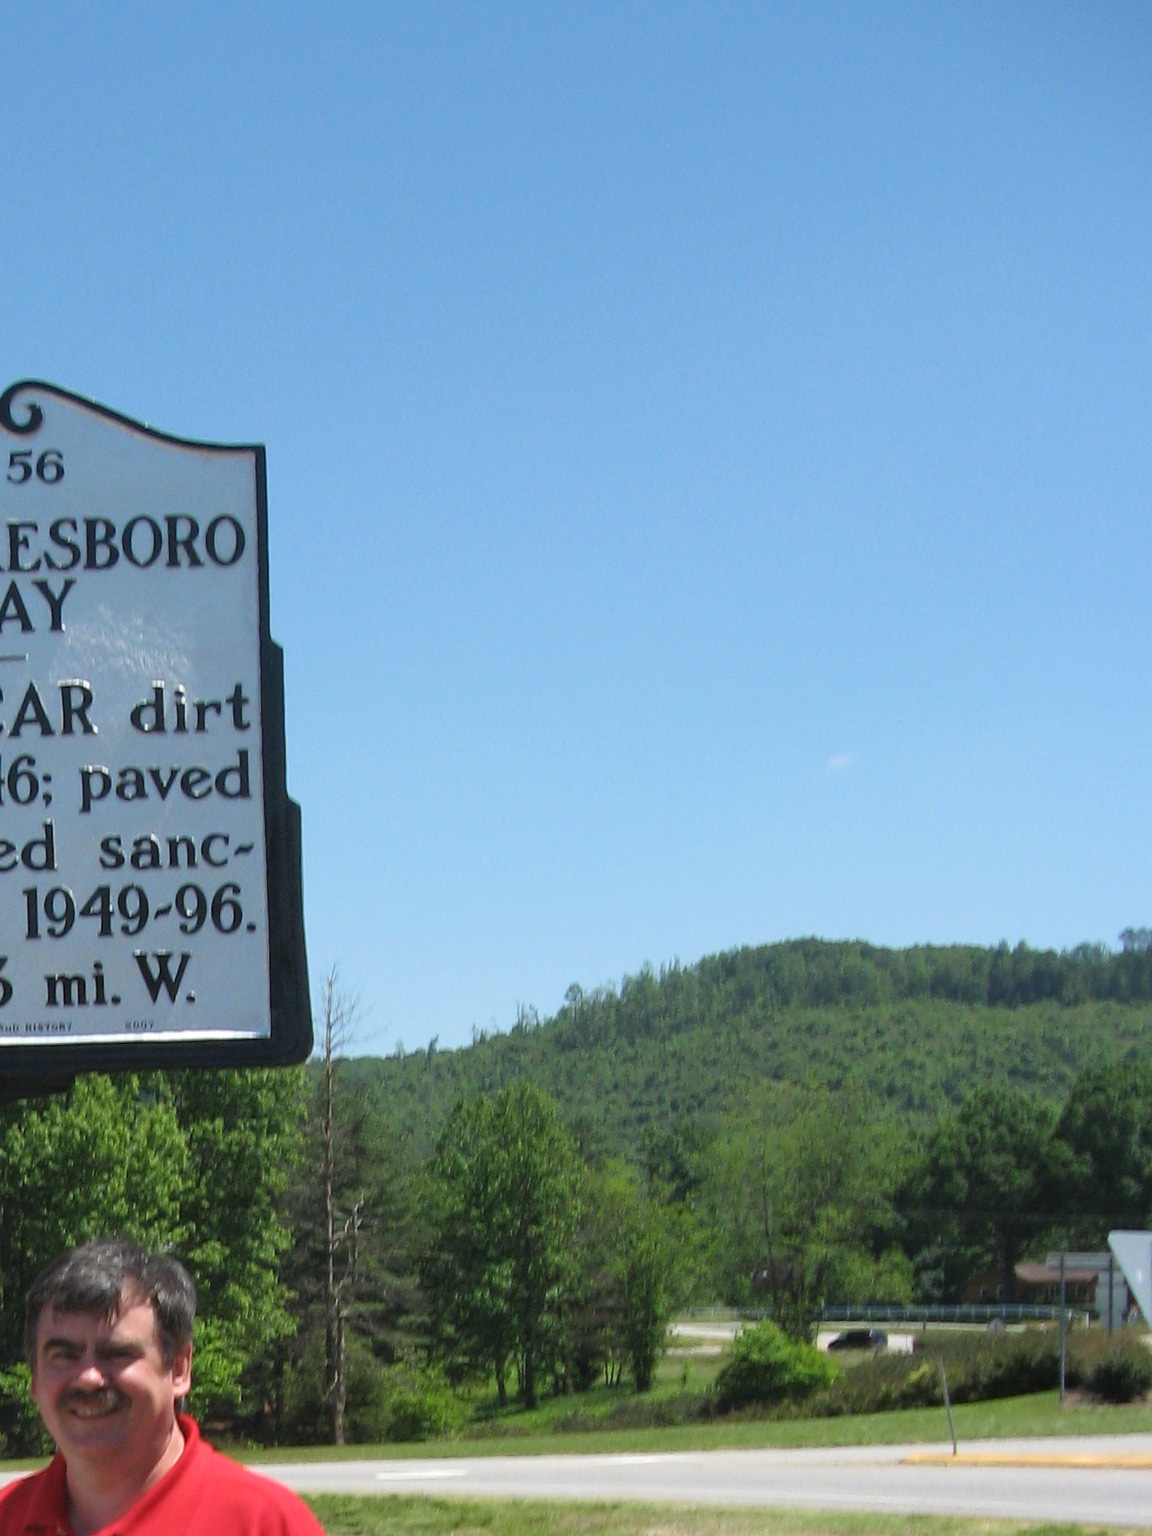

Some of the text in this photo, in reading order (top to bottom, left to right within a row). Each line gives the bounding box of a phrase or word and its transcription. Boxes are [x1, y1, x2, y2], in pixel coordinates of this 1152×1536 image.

[6, 450, 65, 483] 56
[131, 682, 252, 733] dirt
[79, 751, 252, 813] paved
[100, 833, 255, 869] sanc-
[24, 884, 257, 940] 1949-96.
[44, 961, 120, 1008] mi.
[134, 951, 196, 1005] W.
[25, 1023, 73, 1033] HISTORY
